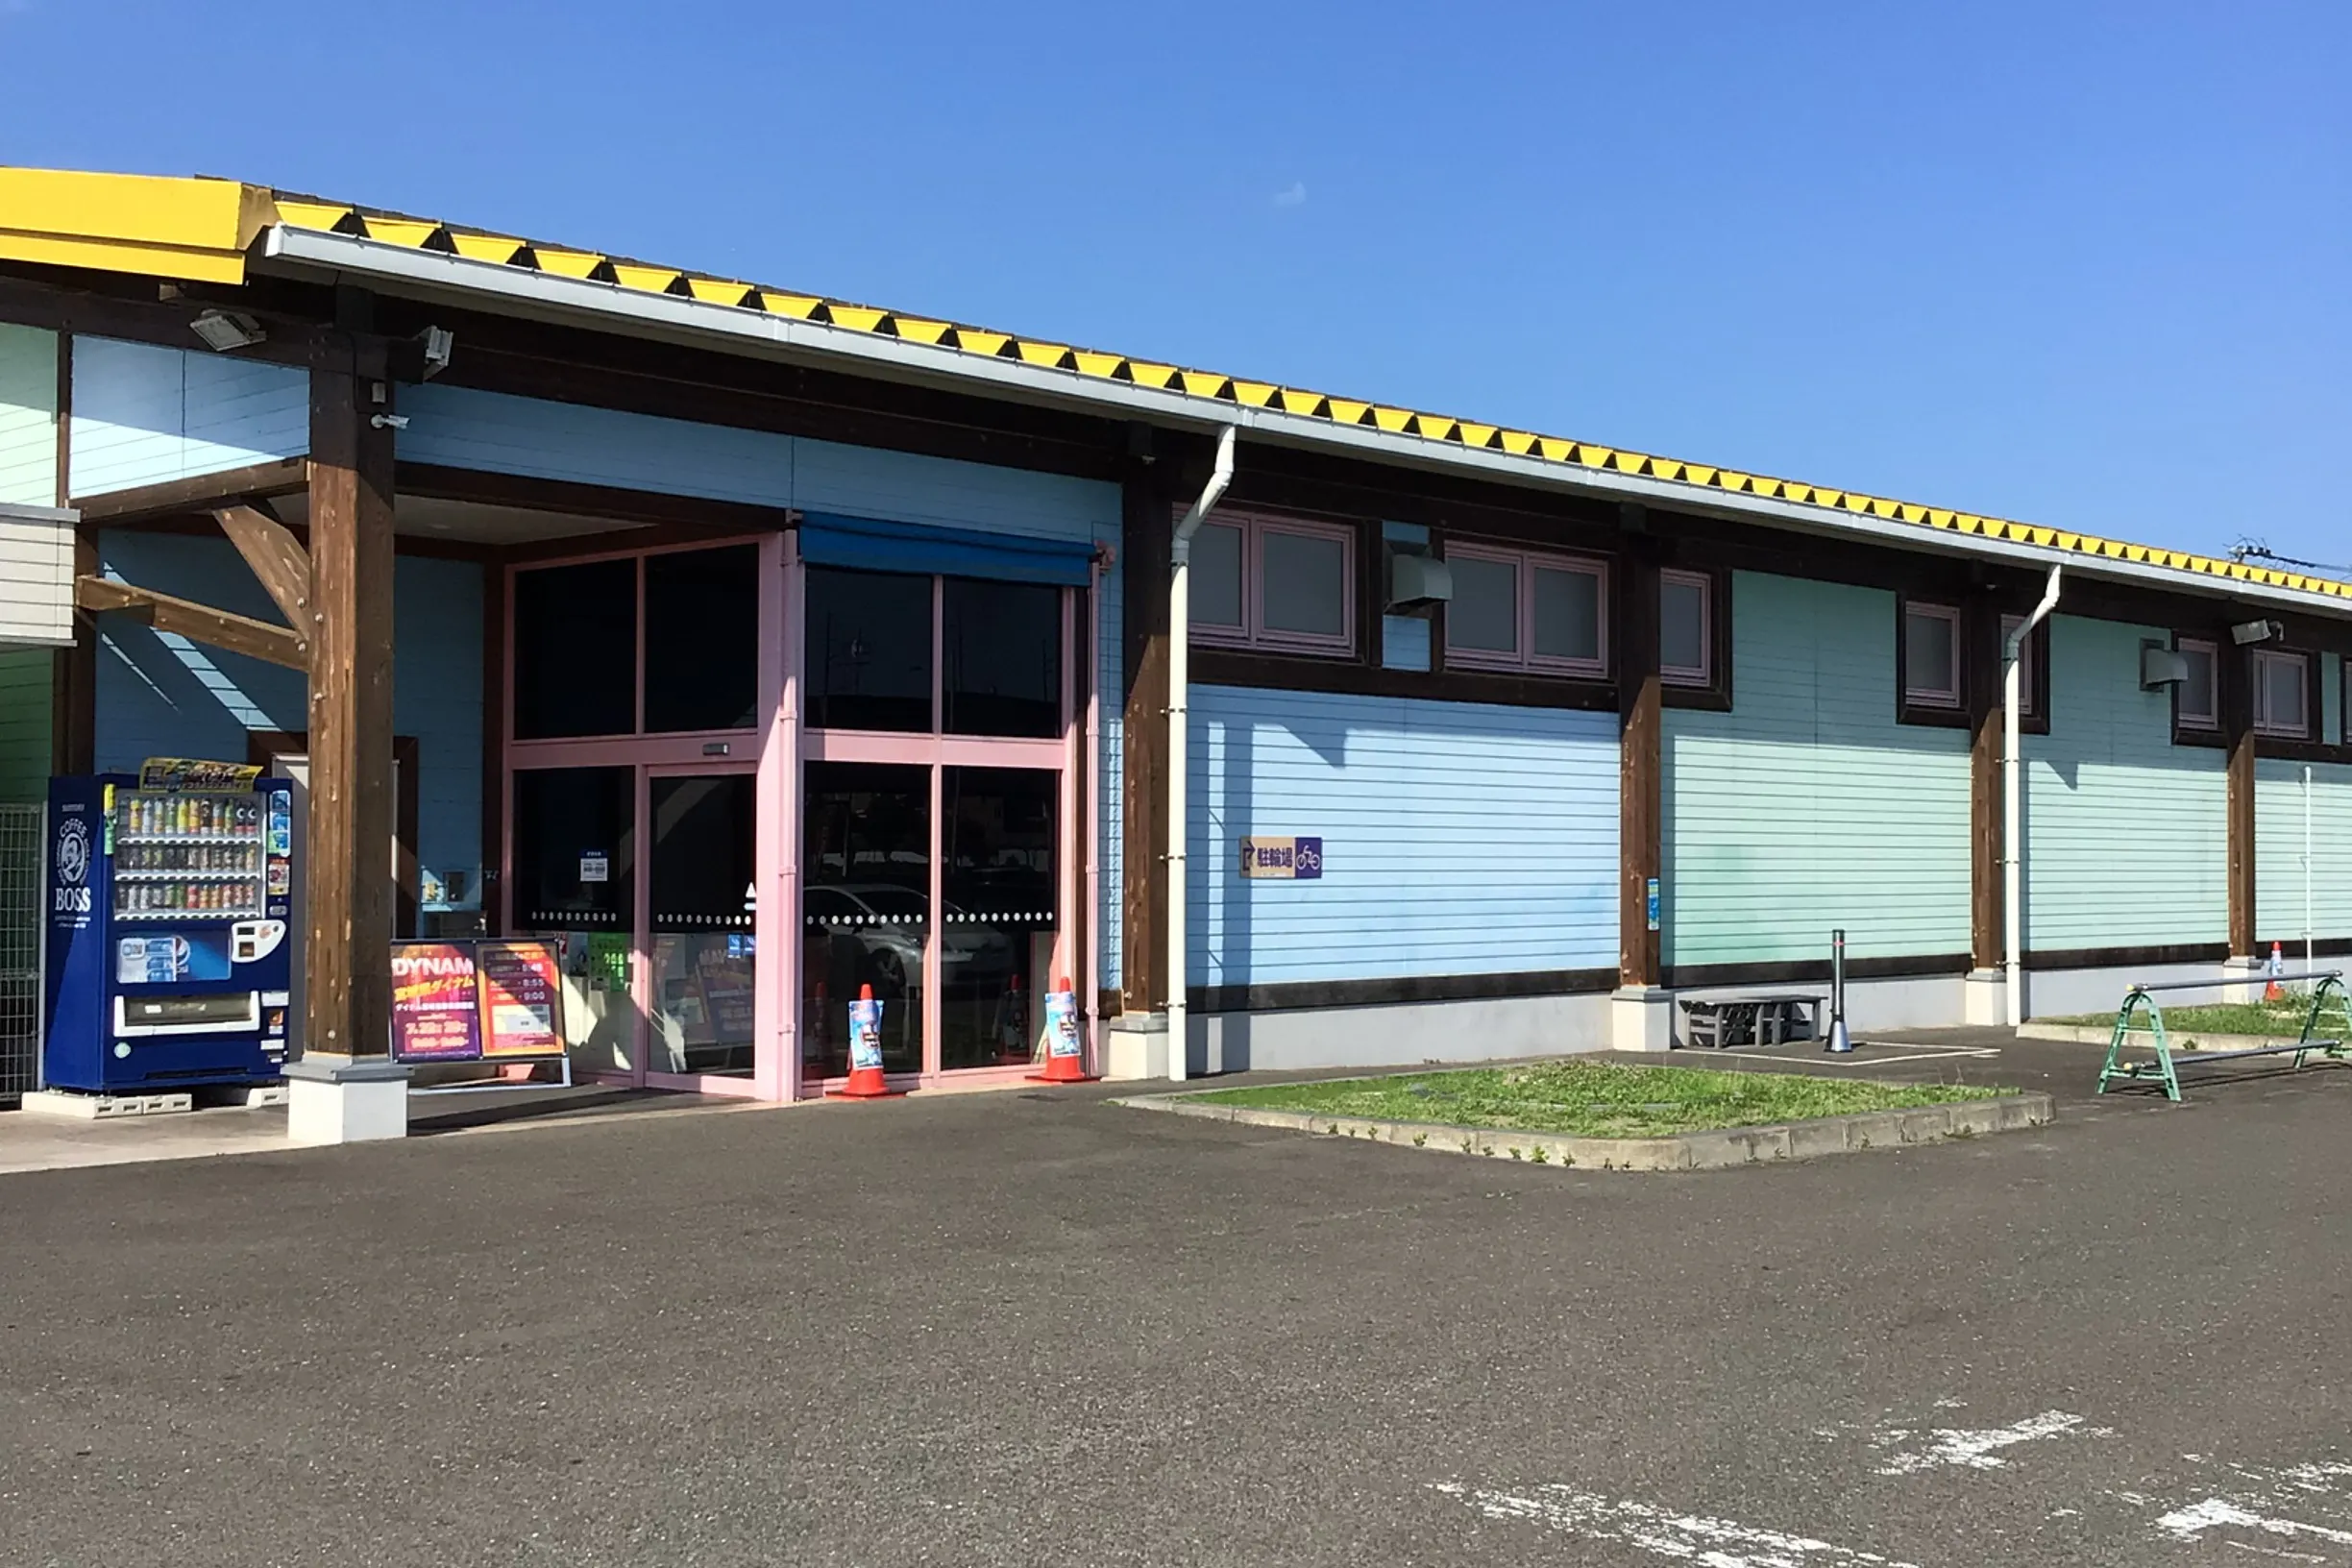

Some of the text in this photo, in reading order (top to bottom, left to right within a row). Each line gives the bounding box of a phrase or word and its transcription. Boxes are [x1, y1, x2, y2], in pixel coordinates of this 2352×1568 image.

[60, 819, 88, 838] COFFEE
[55, 887, 91, 912] BOSS
[391, 957, 475, 976] DYNAM
